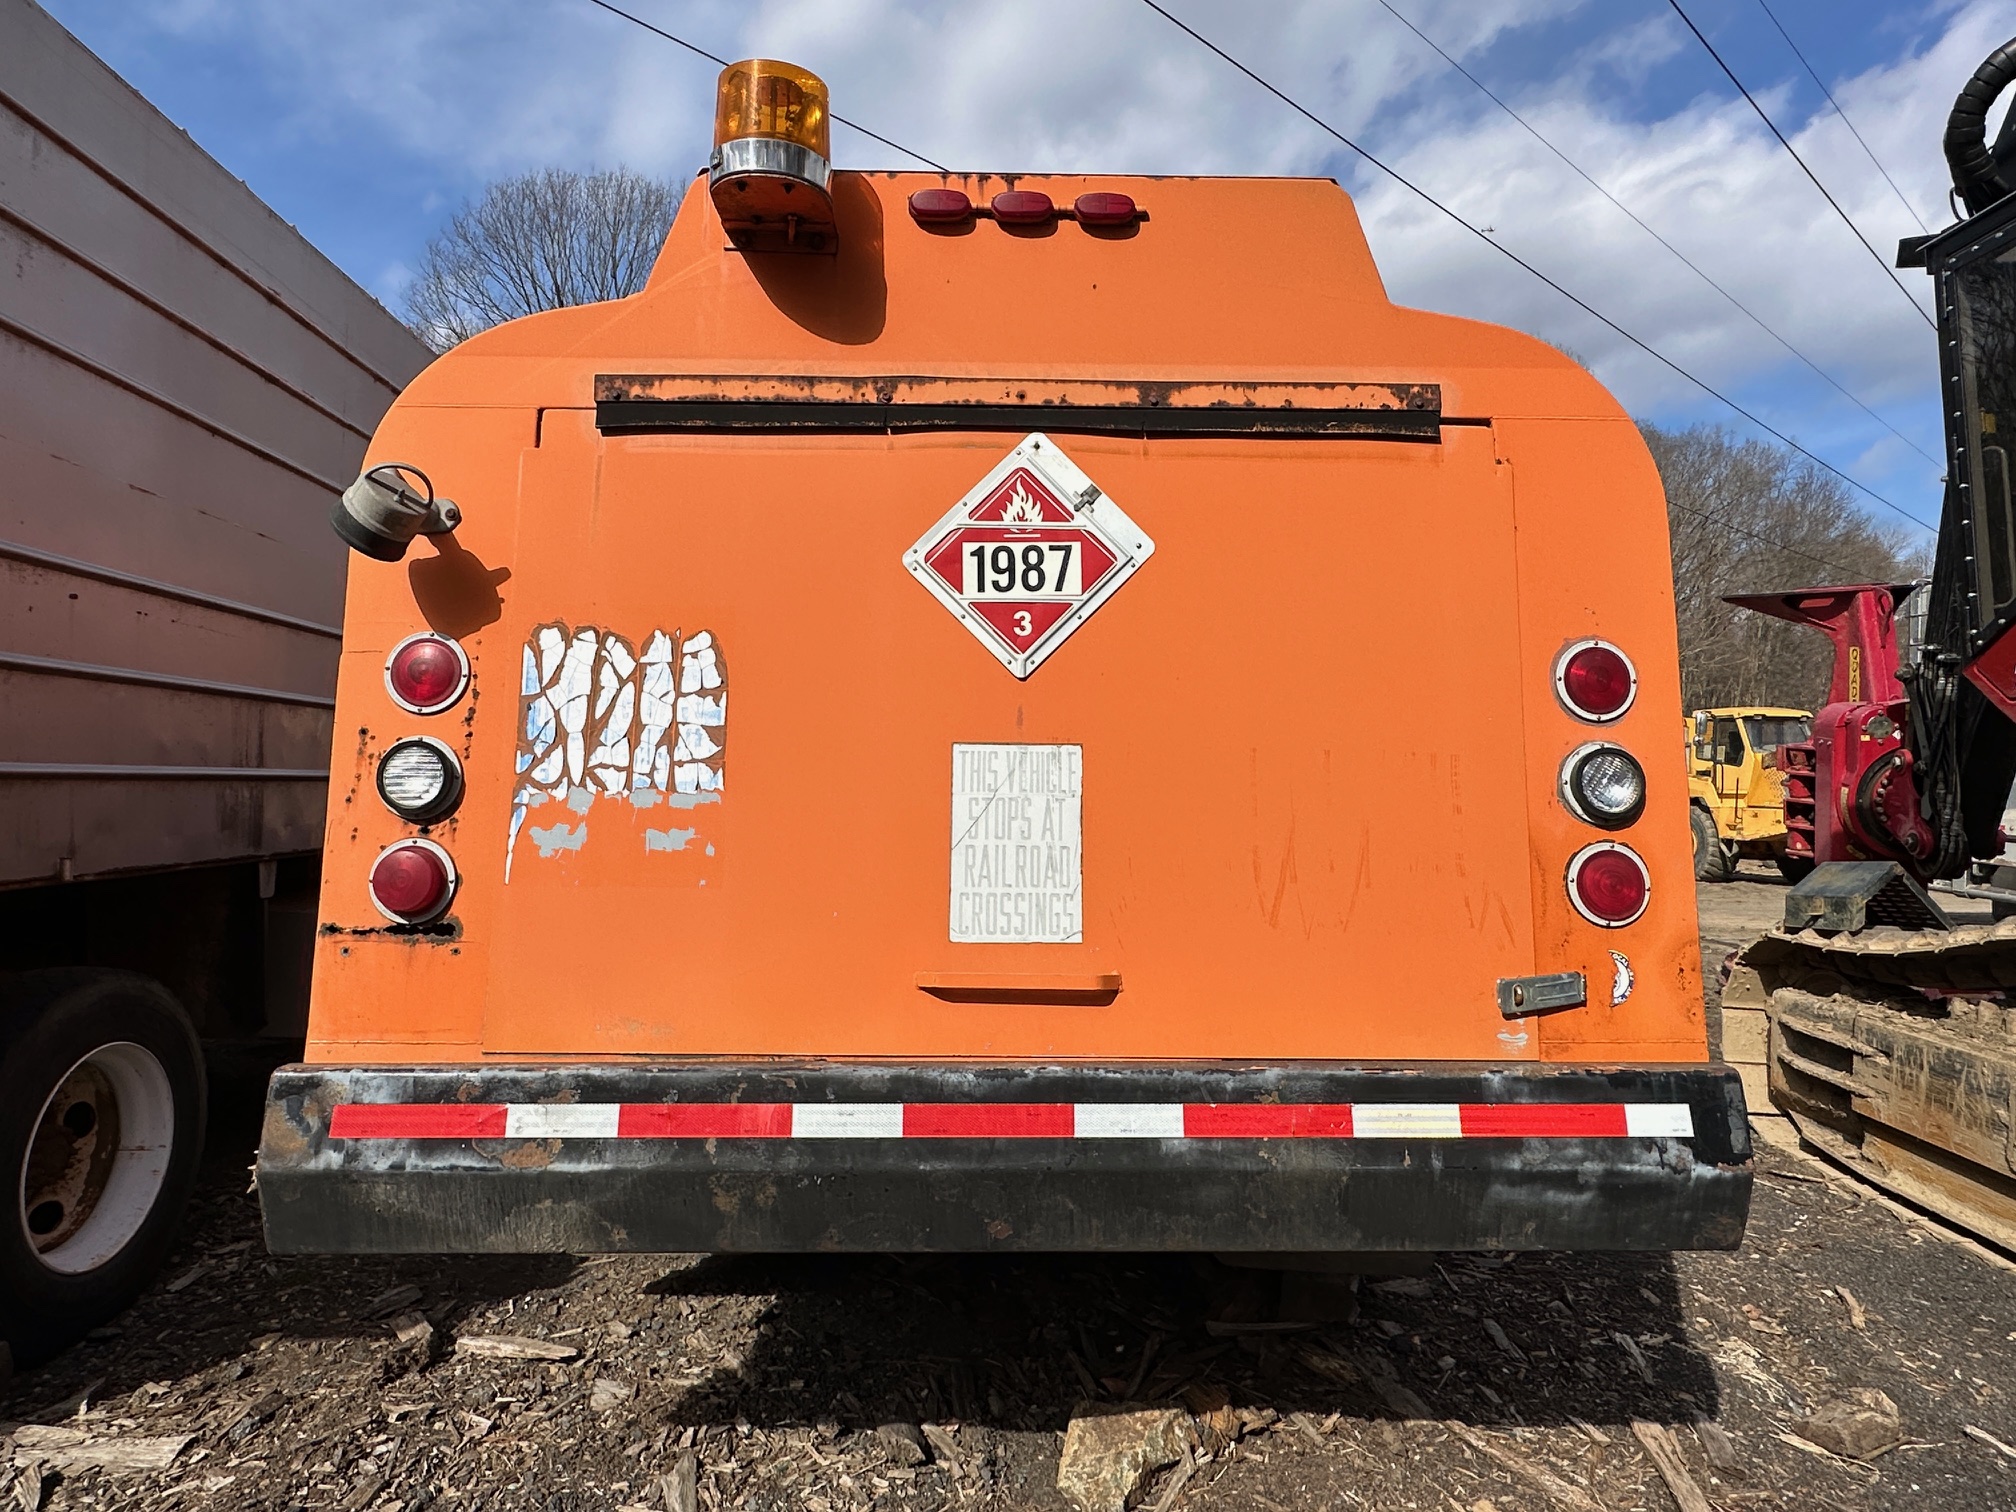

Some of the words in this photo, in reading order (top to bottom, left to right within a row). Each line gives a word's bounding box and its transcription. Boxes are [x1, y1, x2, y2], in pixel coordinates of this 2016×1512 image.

[969, 544, 1073, 593] 1987
[1013, 610, 1033, 637] 3
[959, 750, 999, 793] THIS
[1005, 750, 1077, 794] VEHICLE
[968, 797, 1032, 841] STOPS
[1041, 797, 1066, 841] AT
[964, 844, 1071, 889] RAILROAD
[958, 892, 1074, 936] CROSSINGS
